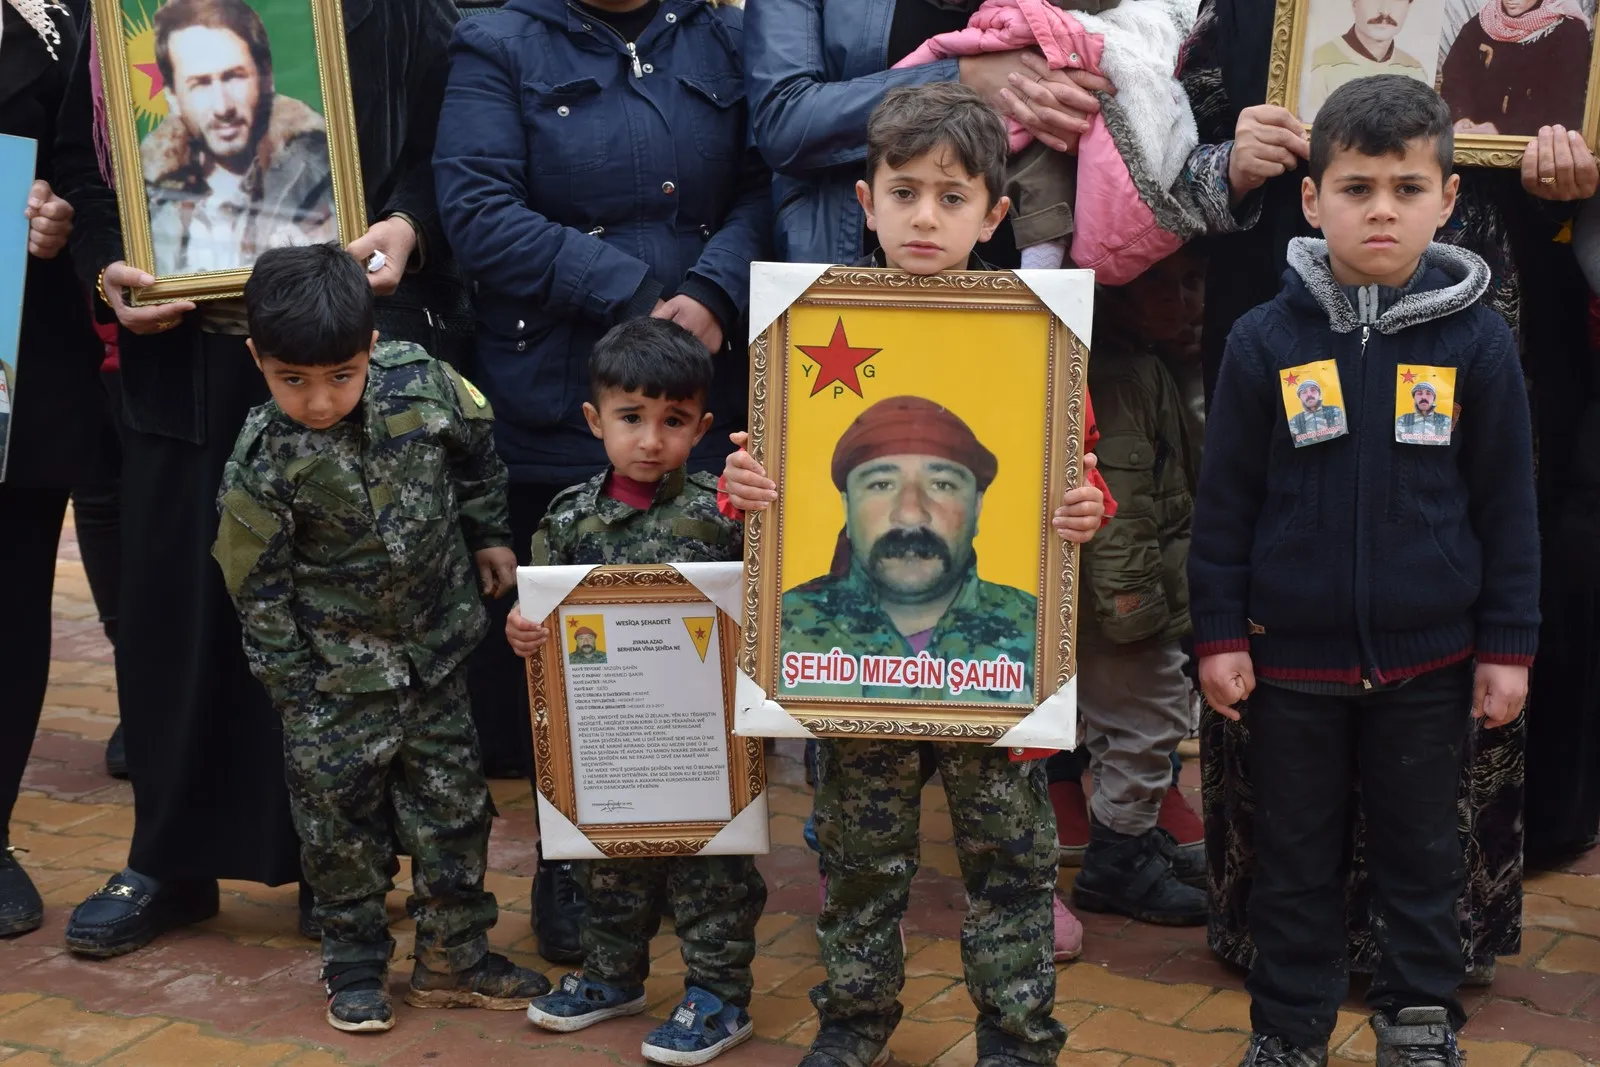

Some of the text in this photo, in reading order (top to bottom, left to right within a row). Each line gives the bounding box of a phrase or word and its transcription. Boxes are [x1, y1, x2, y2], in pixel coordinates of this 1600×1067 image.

[802, 364, 875, 399] Y P G
[641, 618, 671, 626] ŞEHADETÊ
[784, 650, 1022, 692] ŞEHÎD MIZGÎN ŞAHÎN
